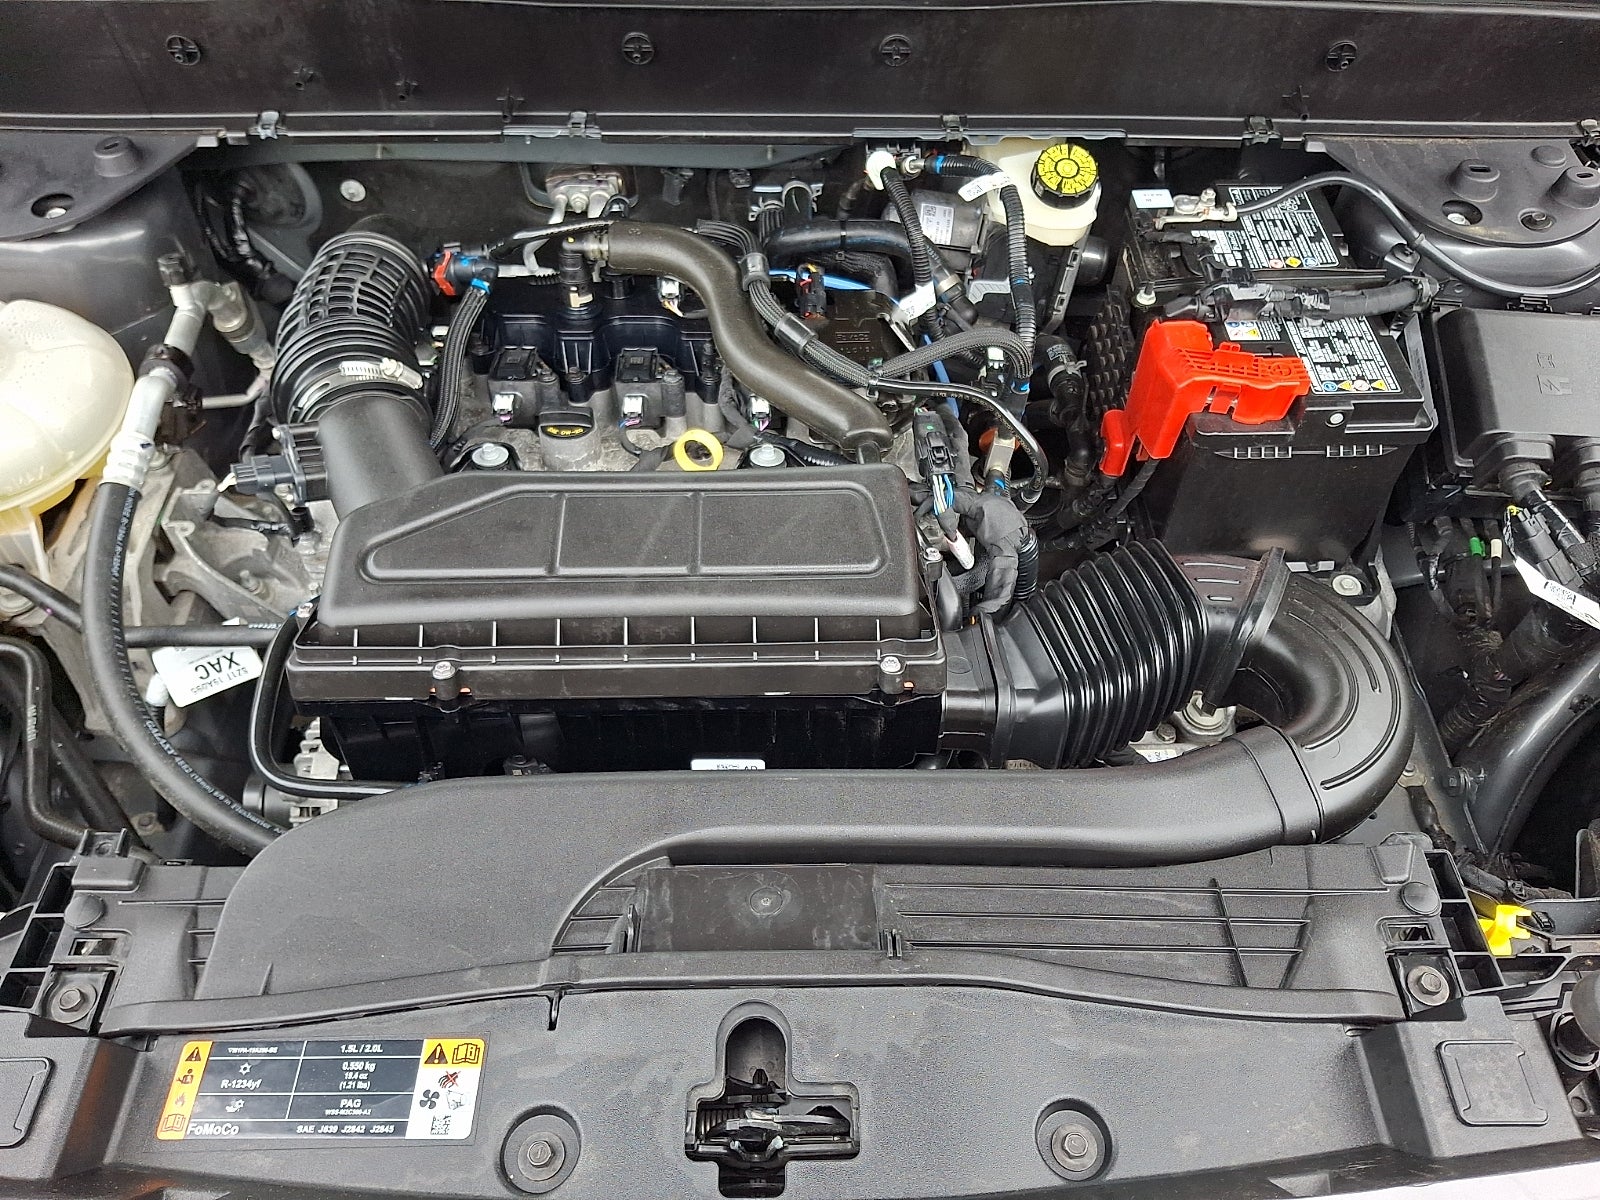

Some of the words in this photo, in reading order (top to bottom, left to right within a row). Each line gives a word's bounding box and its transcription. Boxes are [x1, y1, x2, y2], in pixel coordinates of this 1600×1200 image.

[194, 651, 241, 680] XAC
[145, 720, 177, 756] GALAXY
[340, 1044, 359, 1053] 1.5L
[364, 1044, 383, 1053] 2.0L
[364, 1061, 377, 1072] kg
[220, 1079, 262, 1090] R-1234yf
[340, 1099, 362, 1109] PAG
[186, 1123, 240, 1136] FoMoCo
[296, 1124, 316, 1134] SAE
[340, 1124, 367, 1134] J2842
[369, 1124, 396, 1134] J2845
